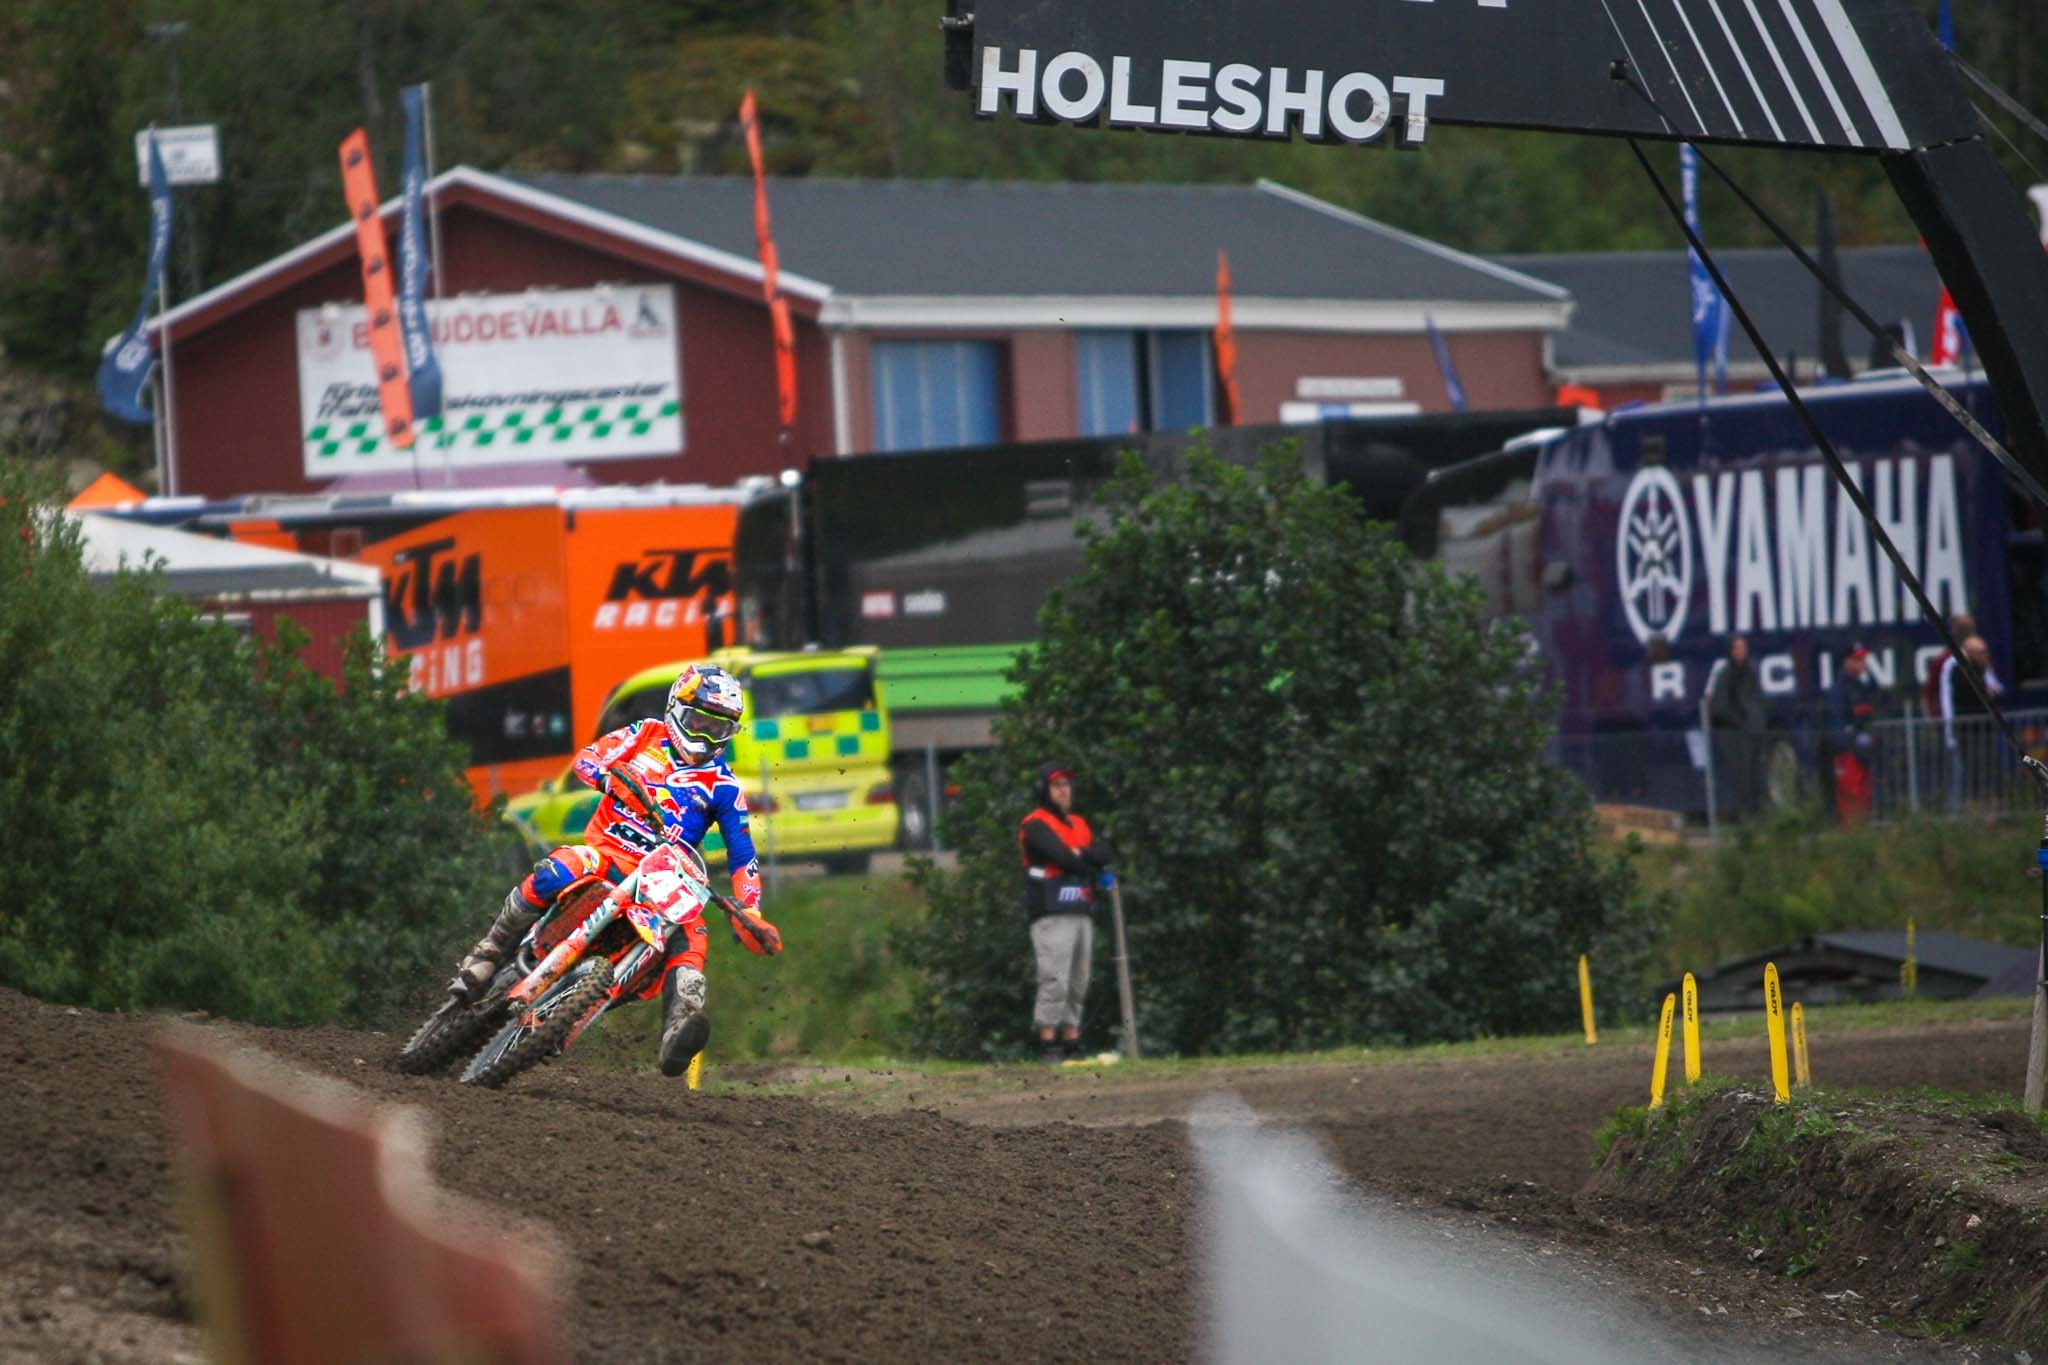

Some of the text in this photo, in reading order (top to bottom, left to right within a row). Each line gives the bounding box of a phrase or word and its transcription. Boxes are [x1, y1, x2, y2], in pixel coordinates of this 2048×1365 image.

[980, 46, 1445, 143] HOLESHOT
[431, 304, 622, 345] UDDEVALLA
[383, 535, 483, 653] KTM
[1693, 454, 1968, 634] YAMAHA
